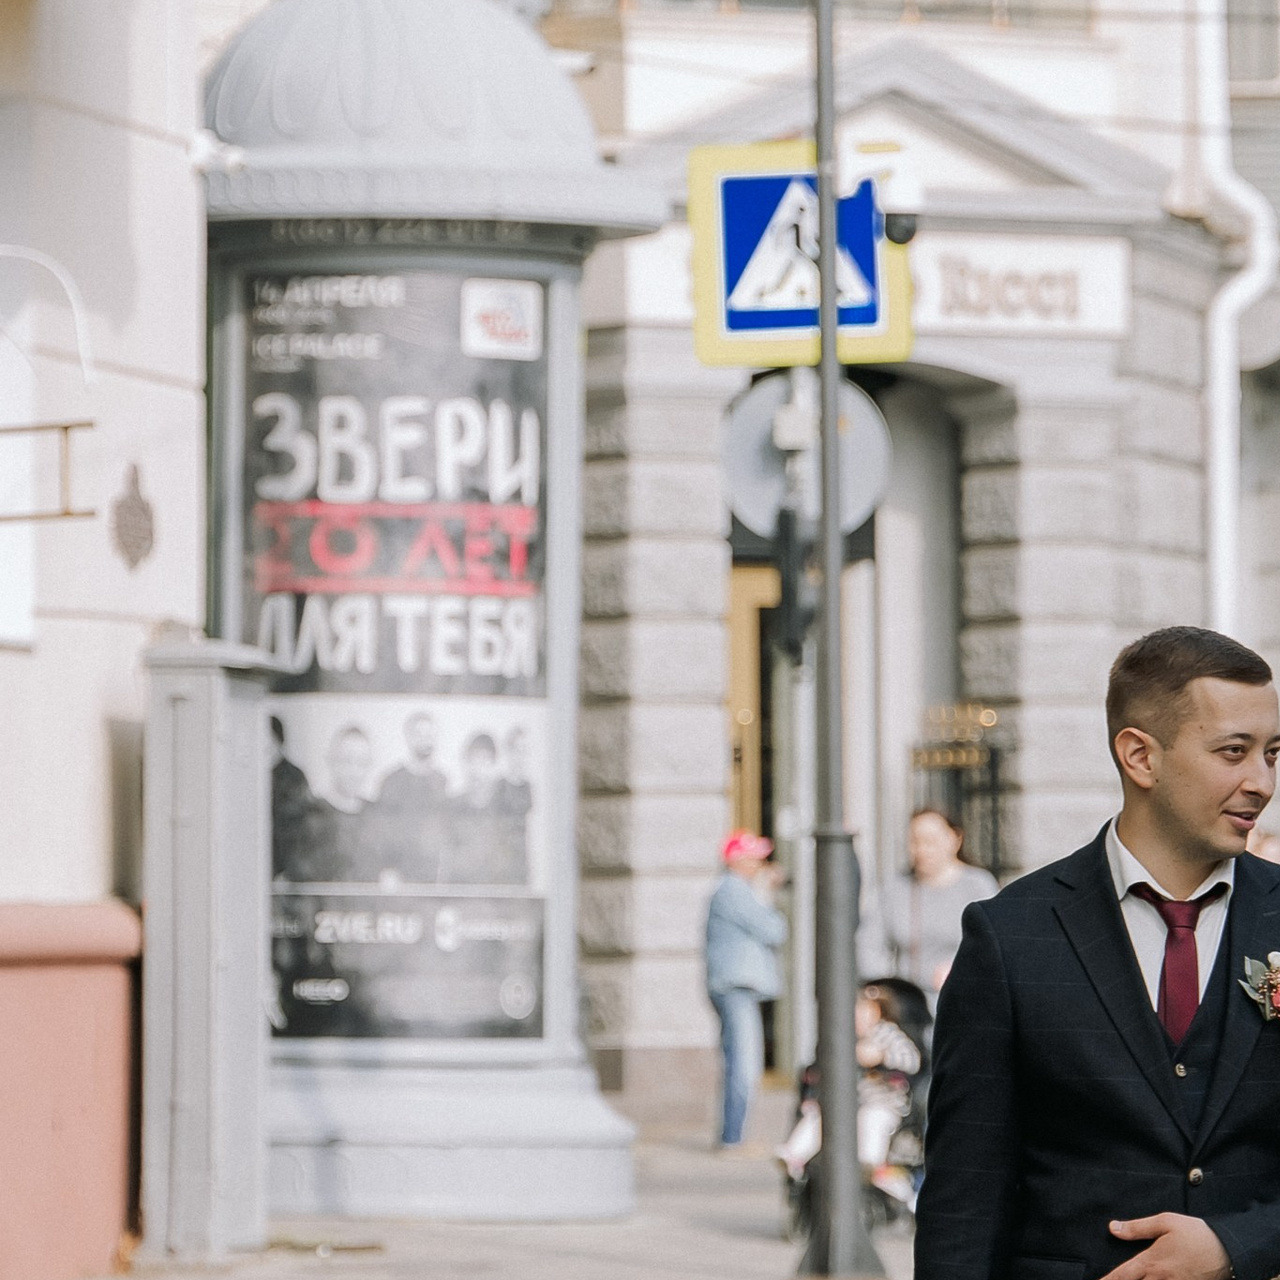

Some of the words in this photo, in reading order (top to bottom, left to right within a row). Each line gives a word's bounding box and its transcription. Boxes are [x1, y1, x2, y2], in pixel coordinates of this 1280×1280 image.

[252, 391, 541, 505] ЗВЕРИ
[400, 506, 538, 588] ЛЕТ
[257, 592, 378, 674] ДЛЯ
[381, 592, 539, 677] ТЕБЯ
